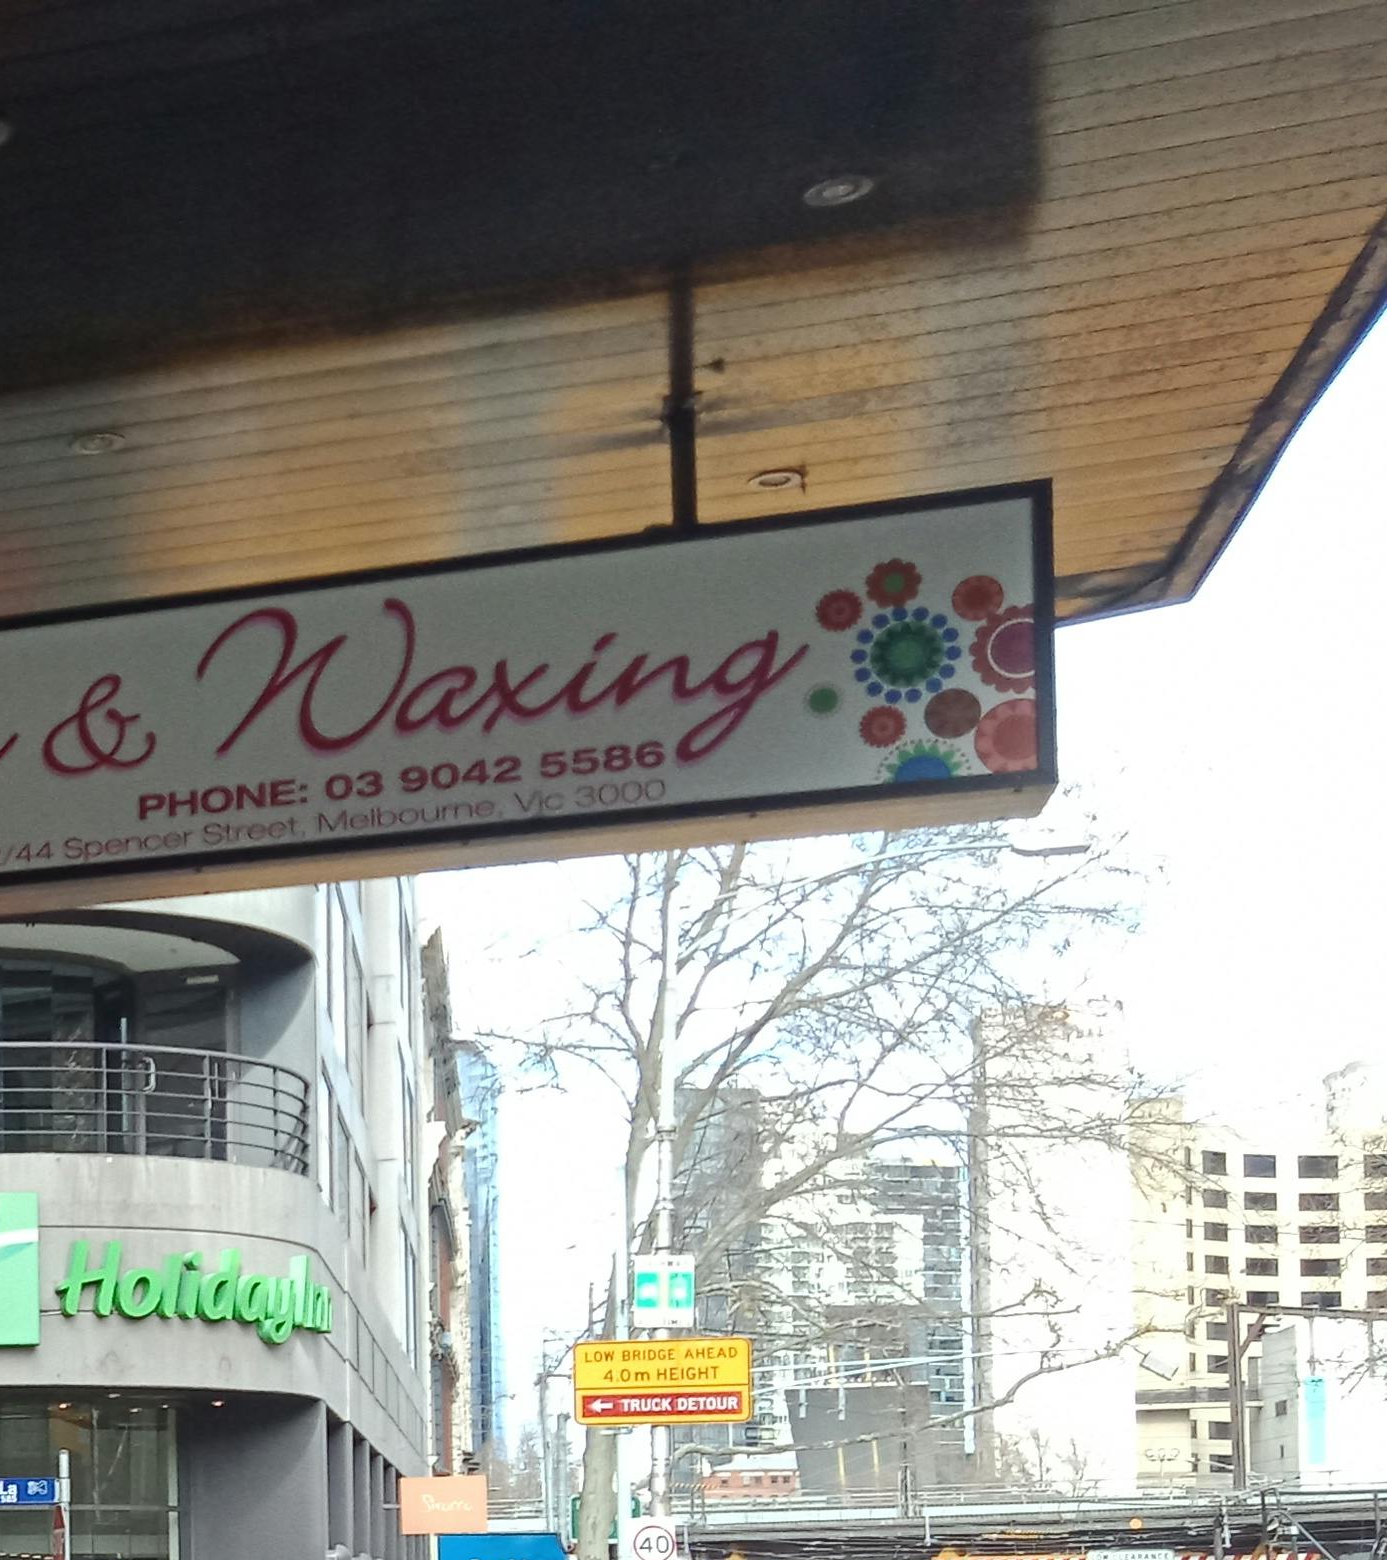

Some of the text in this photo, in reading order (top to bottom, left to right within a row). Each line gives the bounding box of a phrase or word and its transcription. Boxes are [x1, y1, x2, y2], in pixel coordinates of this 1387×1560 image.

[42, 673, 156, 778] &
[195, 598, 809, 770] Waxing
[137, 740, 665, 821] PHONE: 03 9042 5586
[63, 828, 193, 860] Spencer
[202, 816, 306, 846] Street,
[317, 798, 503, 834] Melbourne,
[574, 779, 667, 806] 3000
[55, 1240, 297, 1345] Holiday
[584, 1346, 738, 1363] LOW BRIDGE AHEAD
[656, 1366, 720, 1381] HEIGHT
[620, 1395, 739, 1412] TRUCK DETOUR
[639, 1535, 669, 1553] 40
